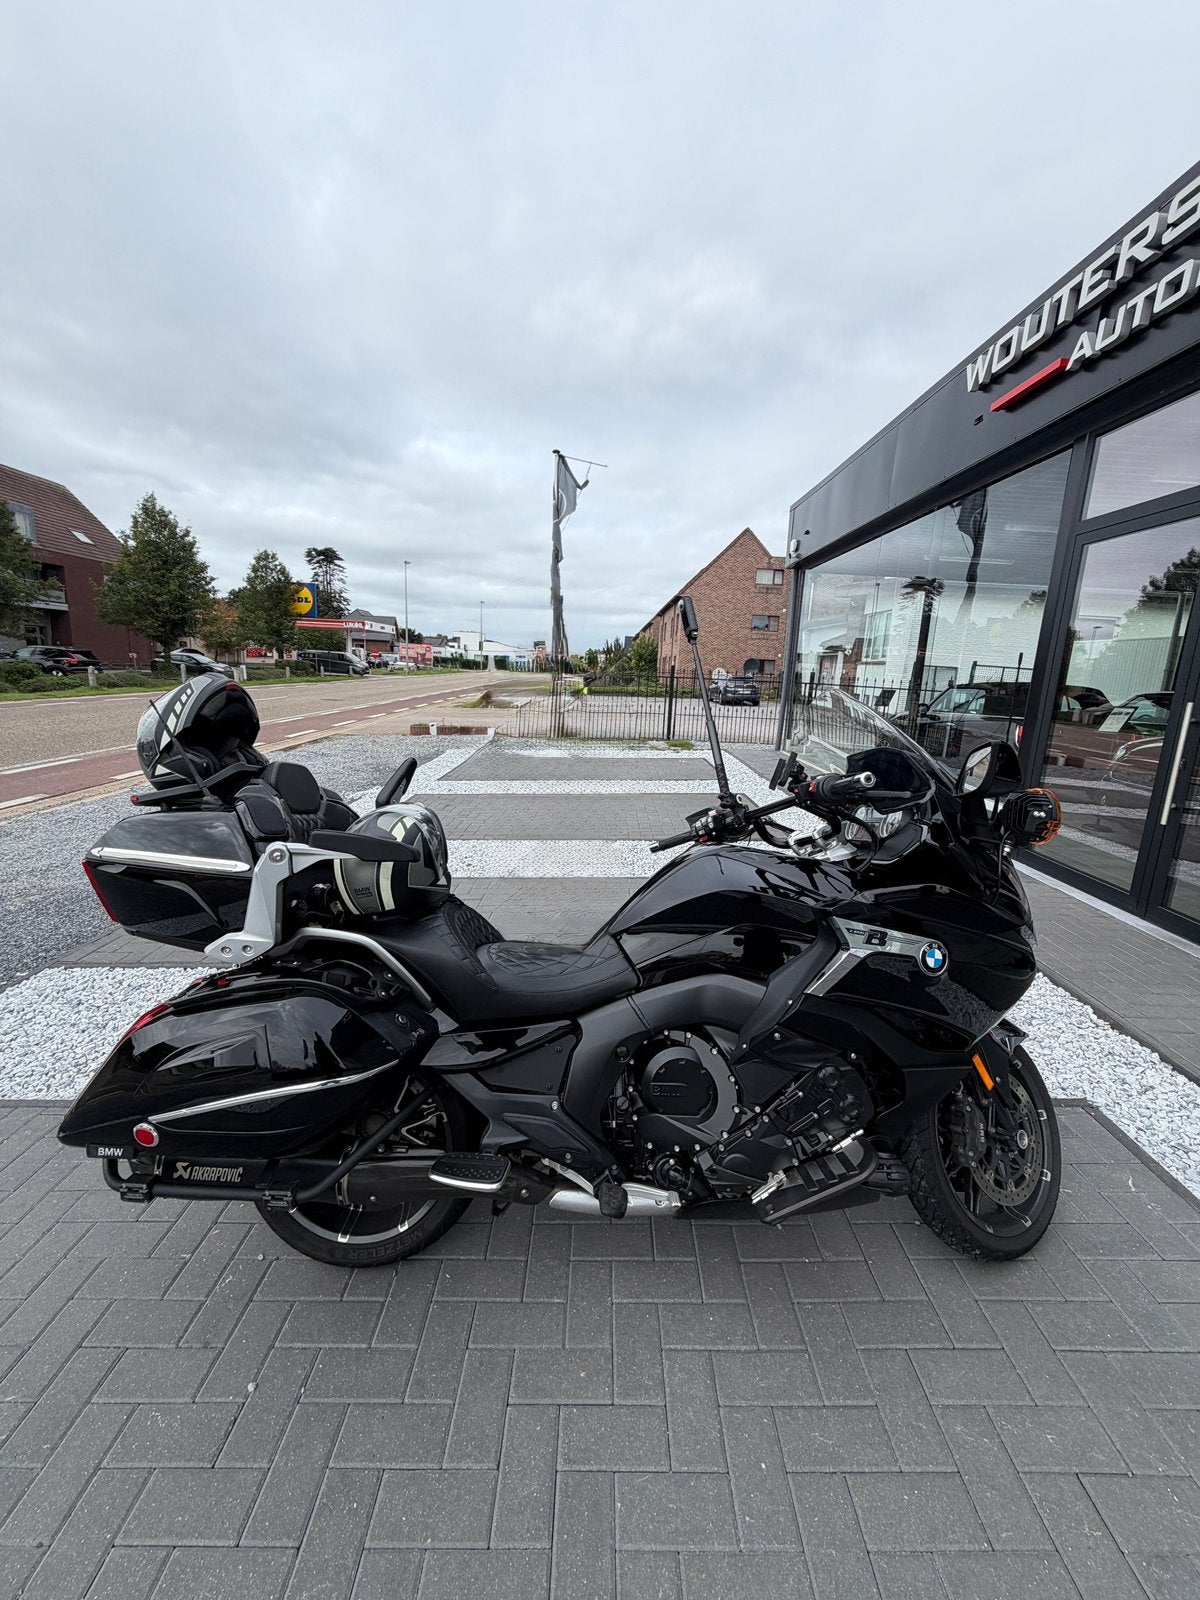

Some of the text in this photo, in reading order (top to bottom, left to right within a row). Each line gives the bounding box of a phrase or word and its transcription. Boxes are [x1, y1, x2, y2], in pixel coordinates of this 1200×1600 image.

[966, 175, 1200, 393] WOUTERS
[1065, 258, 1200, 372] AUTO
[97, 1147, 123, 1156] BMW
[348, 1227, 422, 1260] METZELER
